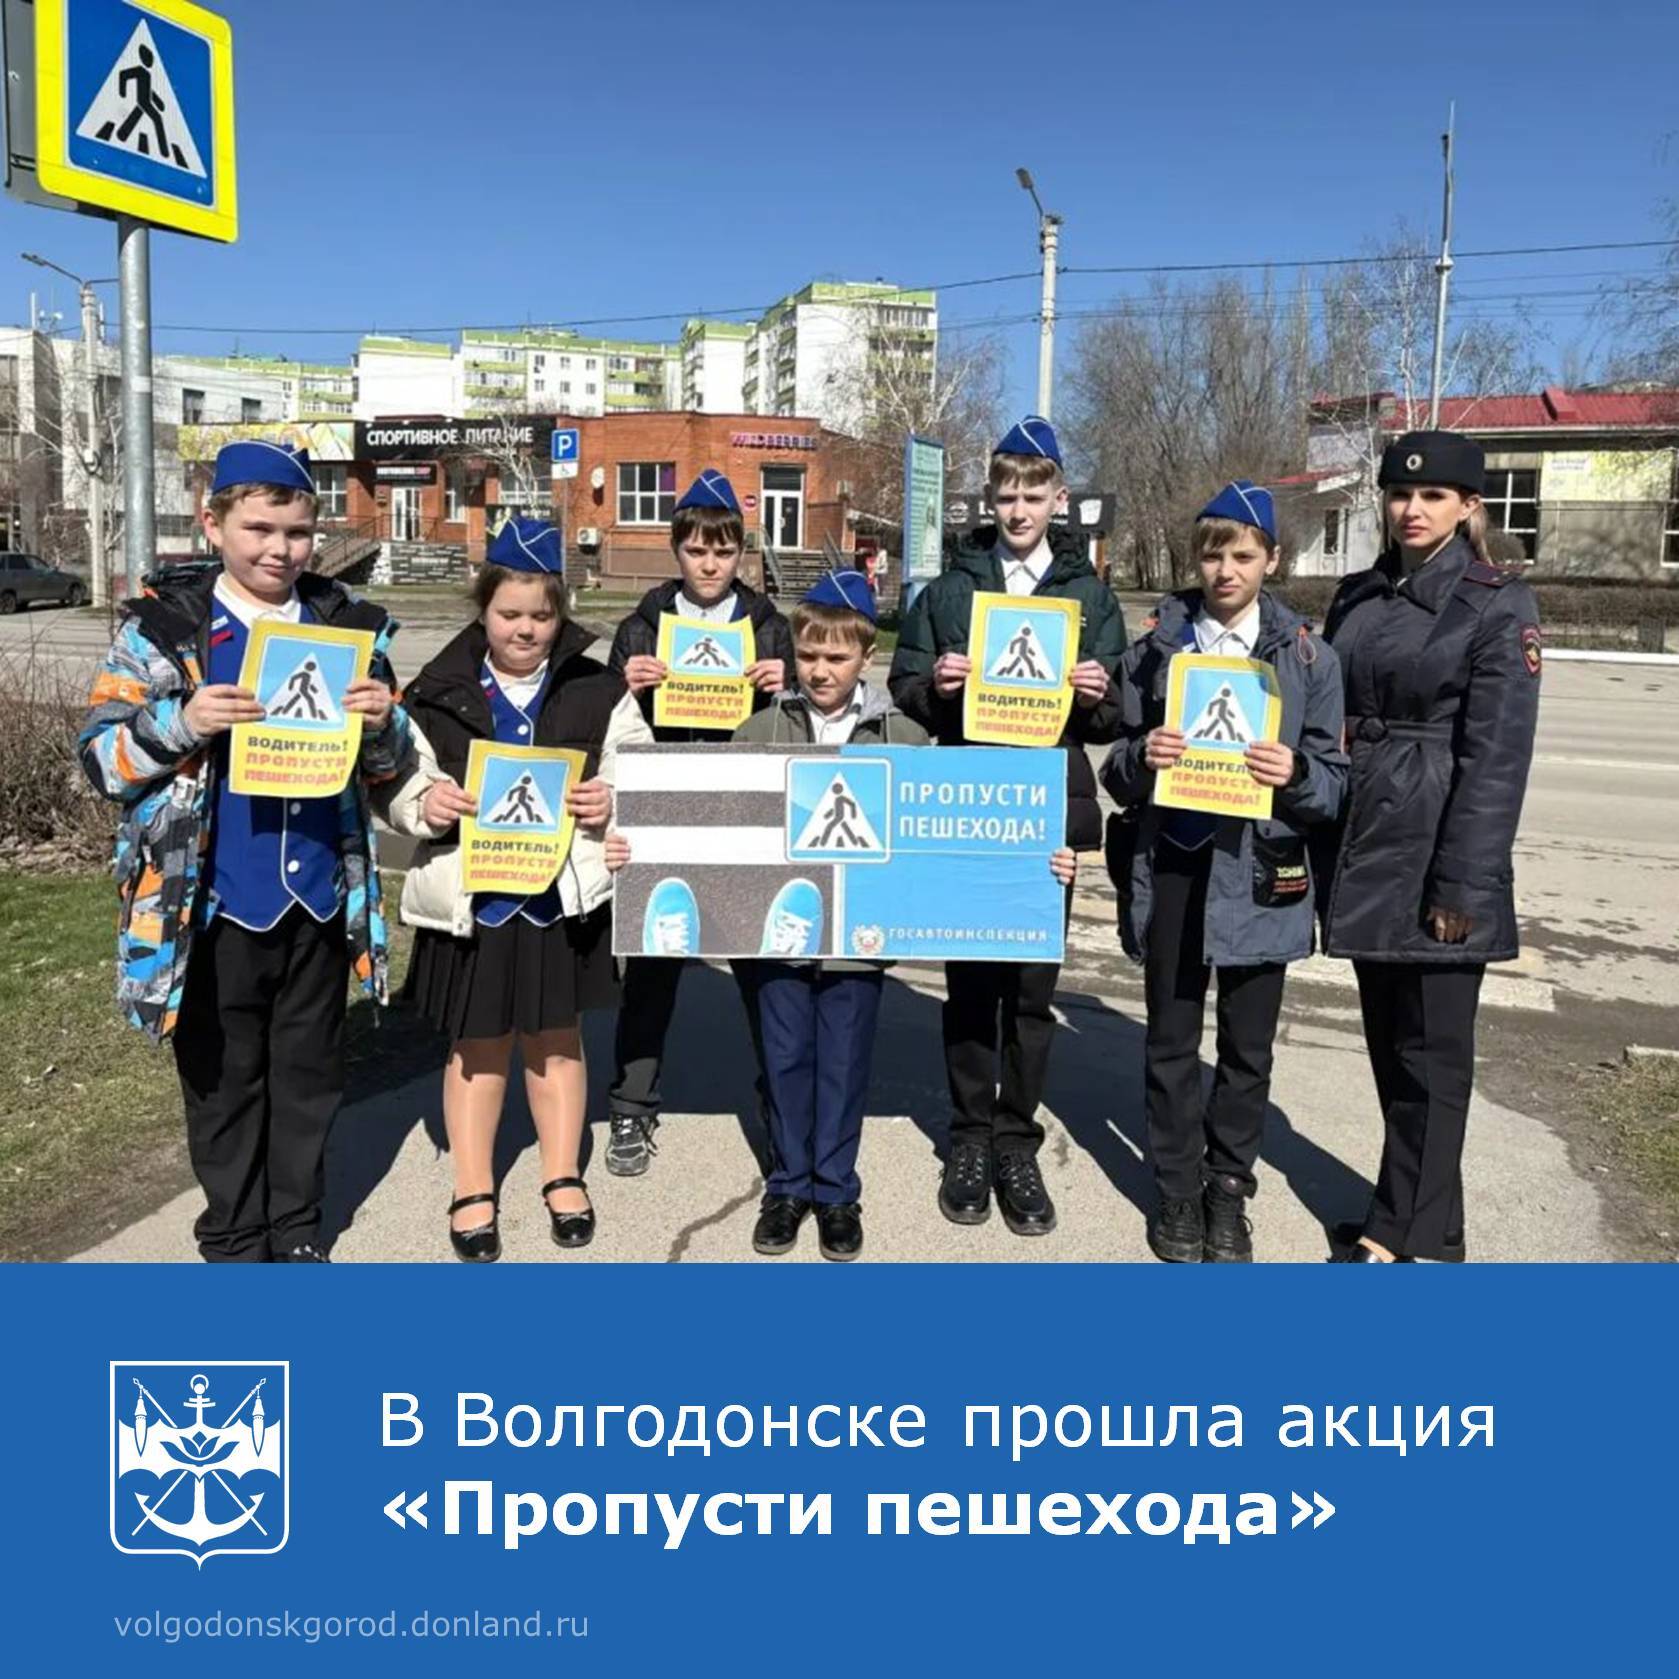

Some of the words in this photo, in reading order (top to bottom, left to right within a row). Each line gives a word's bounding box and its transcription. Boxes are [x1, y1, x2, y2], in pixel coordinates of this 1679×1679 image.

[366, 428, 458, 446] СПОРТИВНОЕ
[465, 427, 533, 444] ПИТАНИЕ
[667, 681, 744, 694] ВОДИТЕЛЬ!
[666, 693, 744, 707] ПРОПУСТИ
[978, 693, 1062, 710] ВОДИТЕЛЬ!
[666, 707, 742, 720] ПЕШЕХОДА!
[976, 707, 1061, 723] ПРОПУСТИ
[975, 721, 1059, 737] ПЕШЕХОДА!
[248, 736, 348, 752] ВОДИТЕЛЬ!
[246, 752, 347, 768] ПРОПУСТИ
[1174, 758, 1249, 774] ВОДИТЕЛ
[244, 769, 345, 785] ПЕШЕХОДА!
[900, 782, 1047, 806] ПРОПУСТИ
[1170, 785, 1261, 806] ПЕШЕХОДА!
[900, 817, 1046, 844] ПЕШЕХОДА!
[472, 840, 560, 855] ВОДИТЕЛЬ!
[470, 854, 557, 868] ПРОПУСТИ
[888, 927, 1048, 942] ГОСАВТОИНСПЕКЦИЯ
